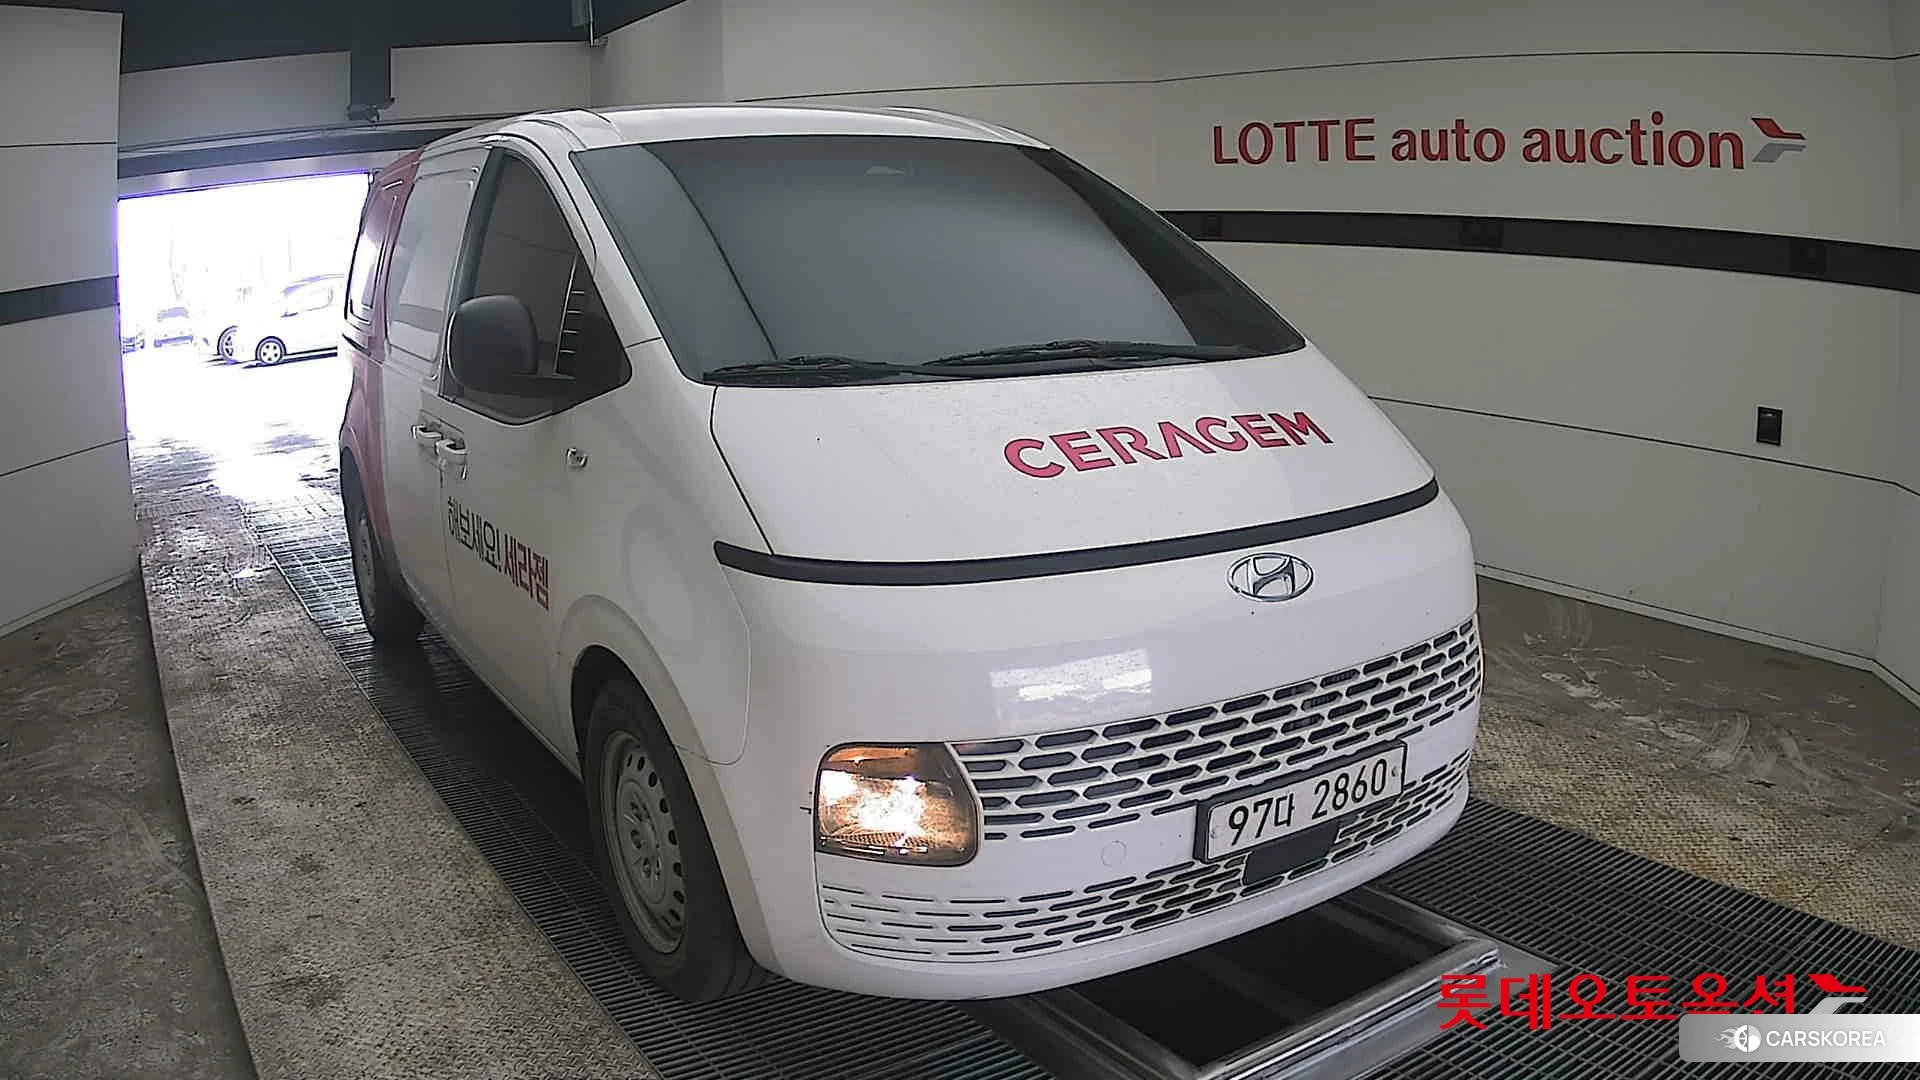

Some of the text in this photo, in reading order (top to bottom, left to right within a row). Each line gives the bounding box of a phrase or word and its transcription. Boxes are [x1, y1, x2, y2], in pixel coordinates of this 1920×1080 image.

[1212, 111, 1745, 170] LOTTE auto auction
[1003, 411, 1334, 479] CERAGEM
[448, 495, 550, 612] 해보세요! 세라젬
[1228, 758, 1388, 847] 97다 2860
